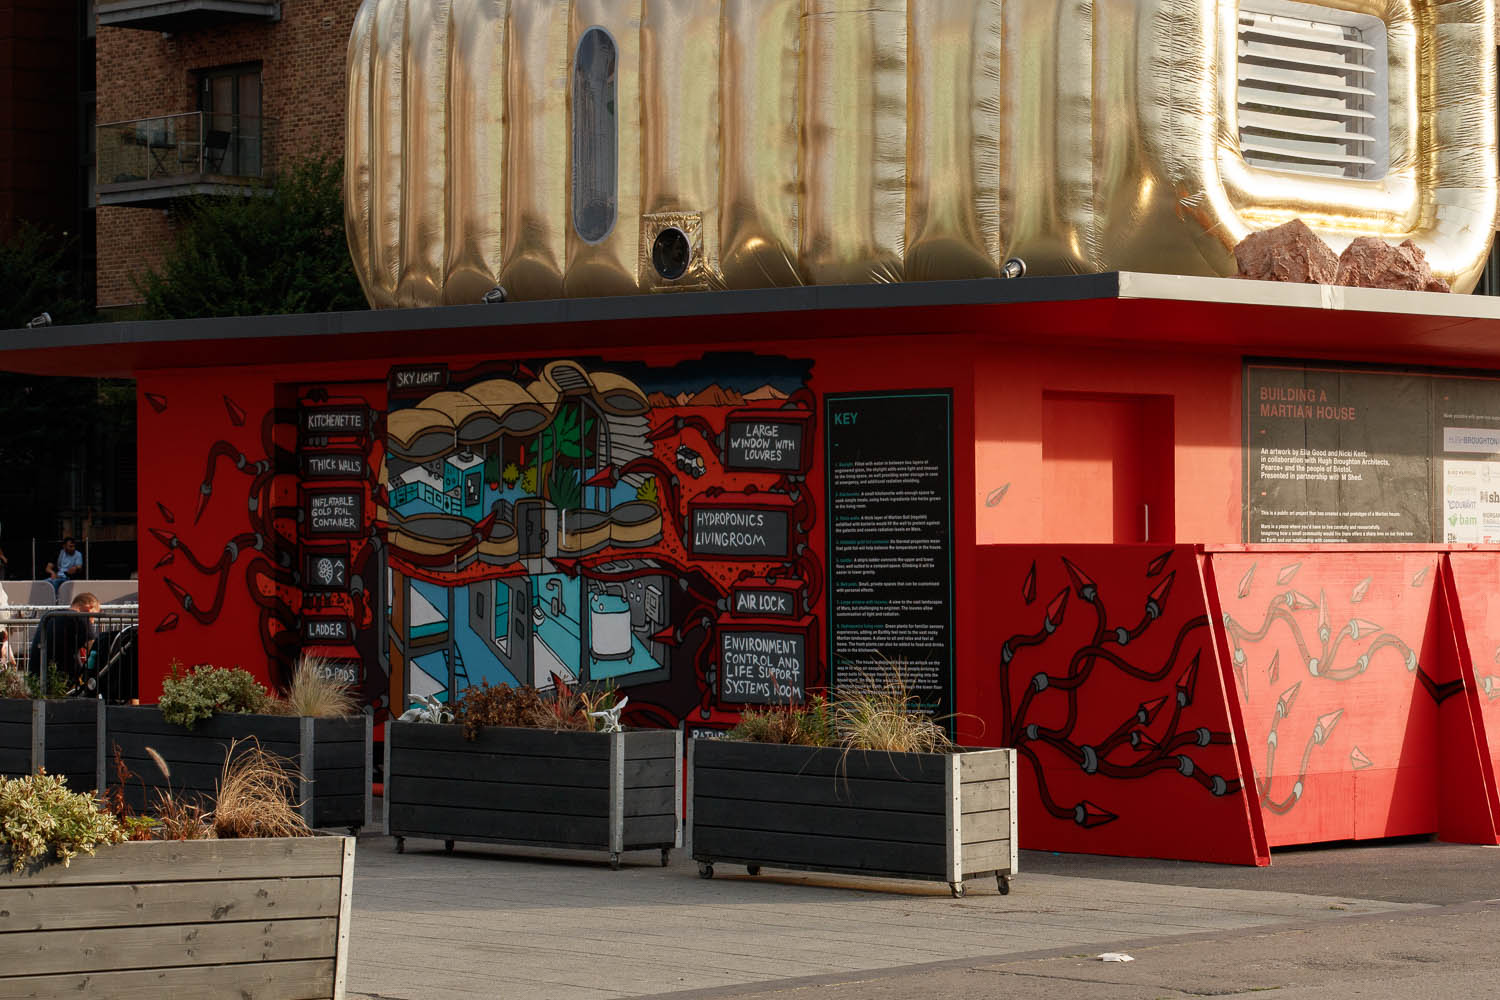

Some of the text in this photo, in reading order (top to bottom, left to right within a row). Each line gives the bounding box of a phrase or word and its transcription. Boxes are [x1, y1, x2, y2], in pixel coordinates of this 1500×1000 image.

[1260, 387, 1327, 402] BUILDING A
[1260, 403, 1356, 420] MARTIAN HOUSE
[308, 415, 361, 429] KITCHENETTE
[834, 413, 858, 424] KEY
[746, 424, 778, 437] LARGE
[731, 438, 795, 450] WINDOW WITH
[745, 450, 782, 461] LOUVRES
[309, 459, 360, 472] THICK WALLS
[1318, 457, 1332, 466] Hugh
[1334, 458, 1360, 467] Broughton
[1362, 458, 1390, 466] Architects,
[1307, 465, 1325, 473] people
[1297, 473, 1327, 481] partnership
[312, 497, 354, 507] INFLATABLE
[334, 508, 351, 516] FOIL
[313, 518, 356, 528] CONTAINER
[697, 512, 764, 526] HYDROPONICS
[1459, 515, 1477, 525] bam
[309, 624, 344, 636] LADDER
[725, 636, 797, 654] ENVIRONMENT
[725, 652, 799, 670] CONTROL AND
[726, 666, 799, 682] LIFE SUPPORT
[725, 679, 801, 699] SYSTEMS ROOM
